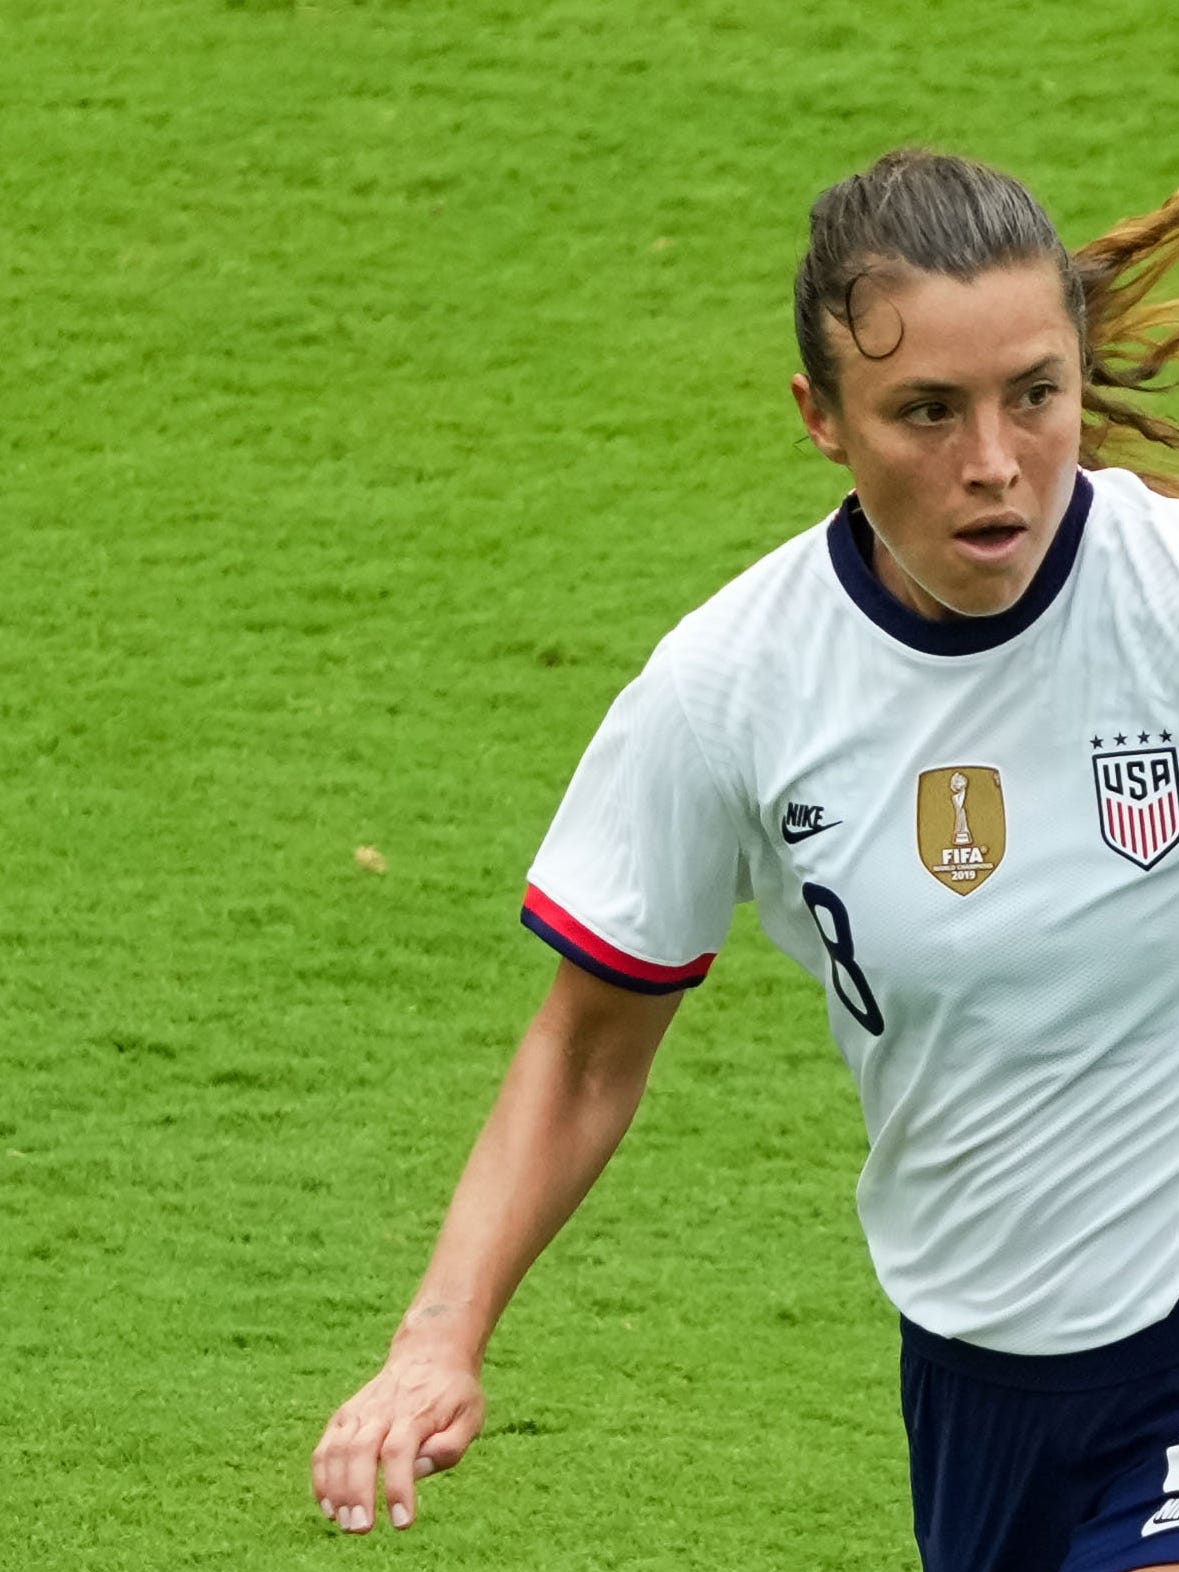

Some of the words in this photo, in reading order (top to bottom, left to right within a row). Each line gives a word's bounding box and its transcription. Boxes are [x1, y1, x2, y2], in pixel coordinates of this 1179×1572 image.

[1103, 759, 1171, 801] USA
[786, 801, 824, 828] NIKE
[942, 847, 983, 864] FIFA
[951, 870, 976, 881] 2019
[803, 882, 884, 1036] 8
